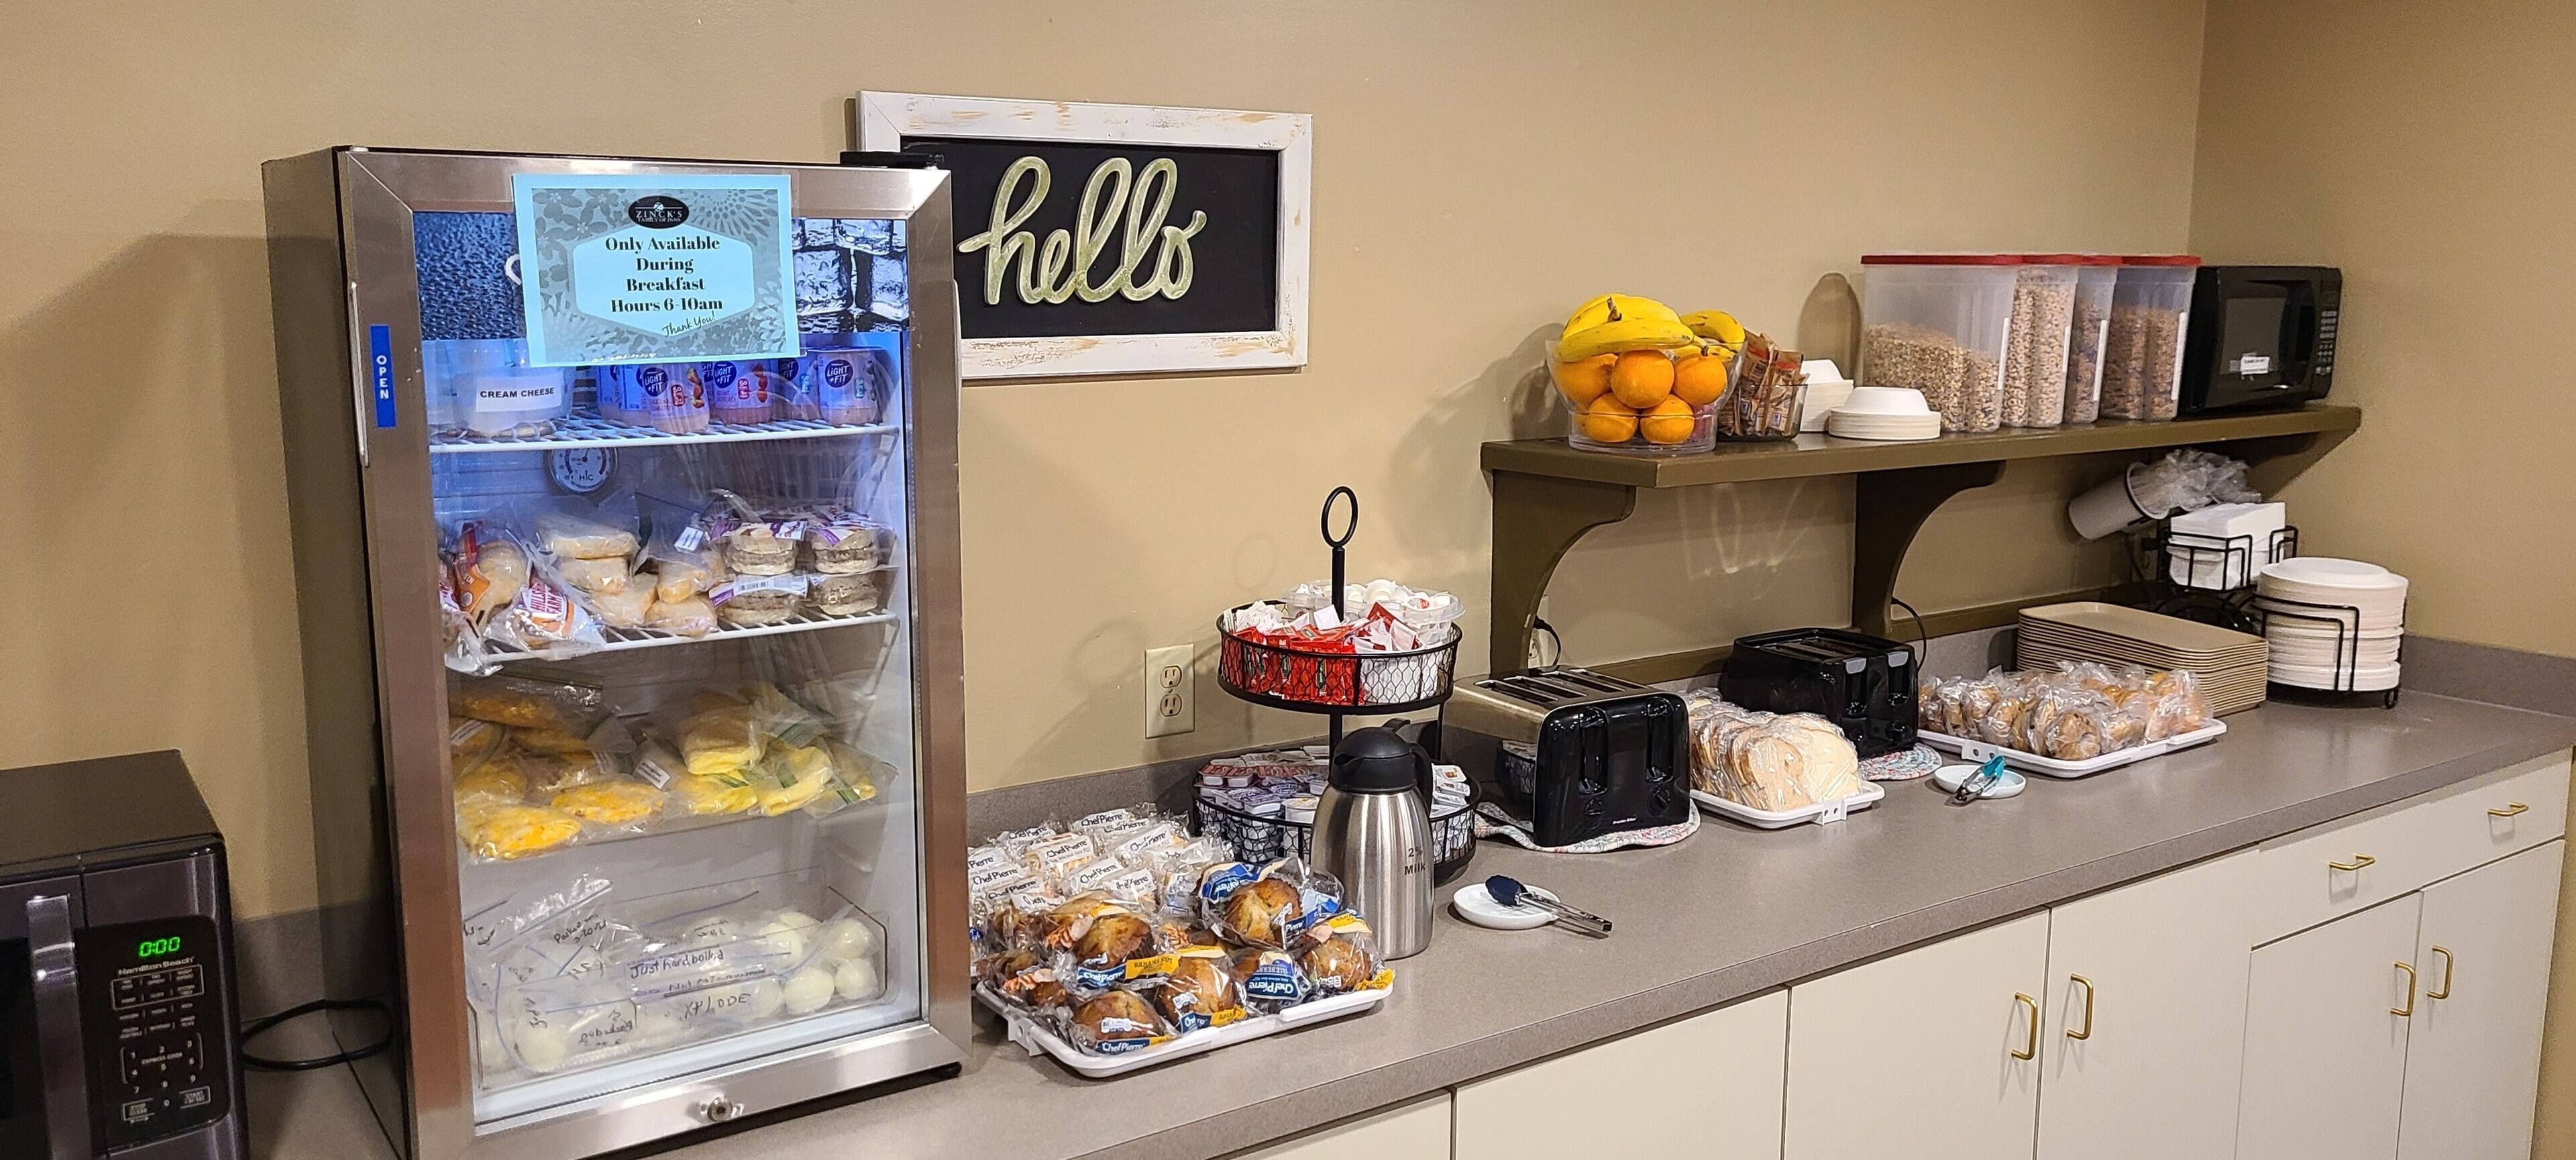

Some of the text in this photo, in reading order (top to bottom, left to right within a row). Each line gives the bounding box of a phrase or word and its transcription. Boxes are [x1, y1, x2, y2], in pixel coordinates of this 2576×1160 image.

[636, 210, 682, 218] ZINCK'S
[957, 156, 1207, 305] hello
[605, 235, 720, 254] Only Available
[637, 257, 694, 274] During
[627, 276, 706, 292] Breakfast
[610, 297, 723, 313] Hours 6-10am
[661, 311, 716, 337] Thank You!
[376, 355, 389, 400] OPEN
[480, 387, 555, 399] CREAM CHEESE
[1408, 846, 1423, 857] 2%
[1404, 862, 1426, 876] Milk
[139, 937, 180, 957] 0:00
[117, 957, 194, 976] Hamilton Beach
[630, 963, 659, 979] Just
